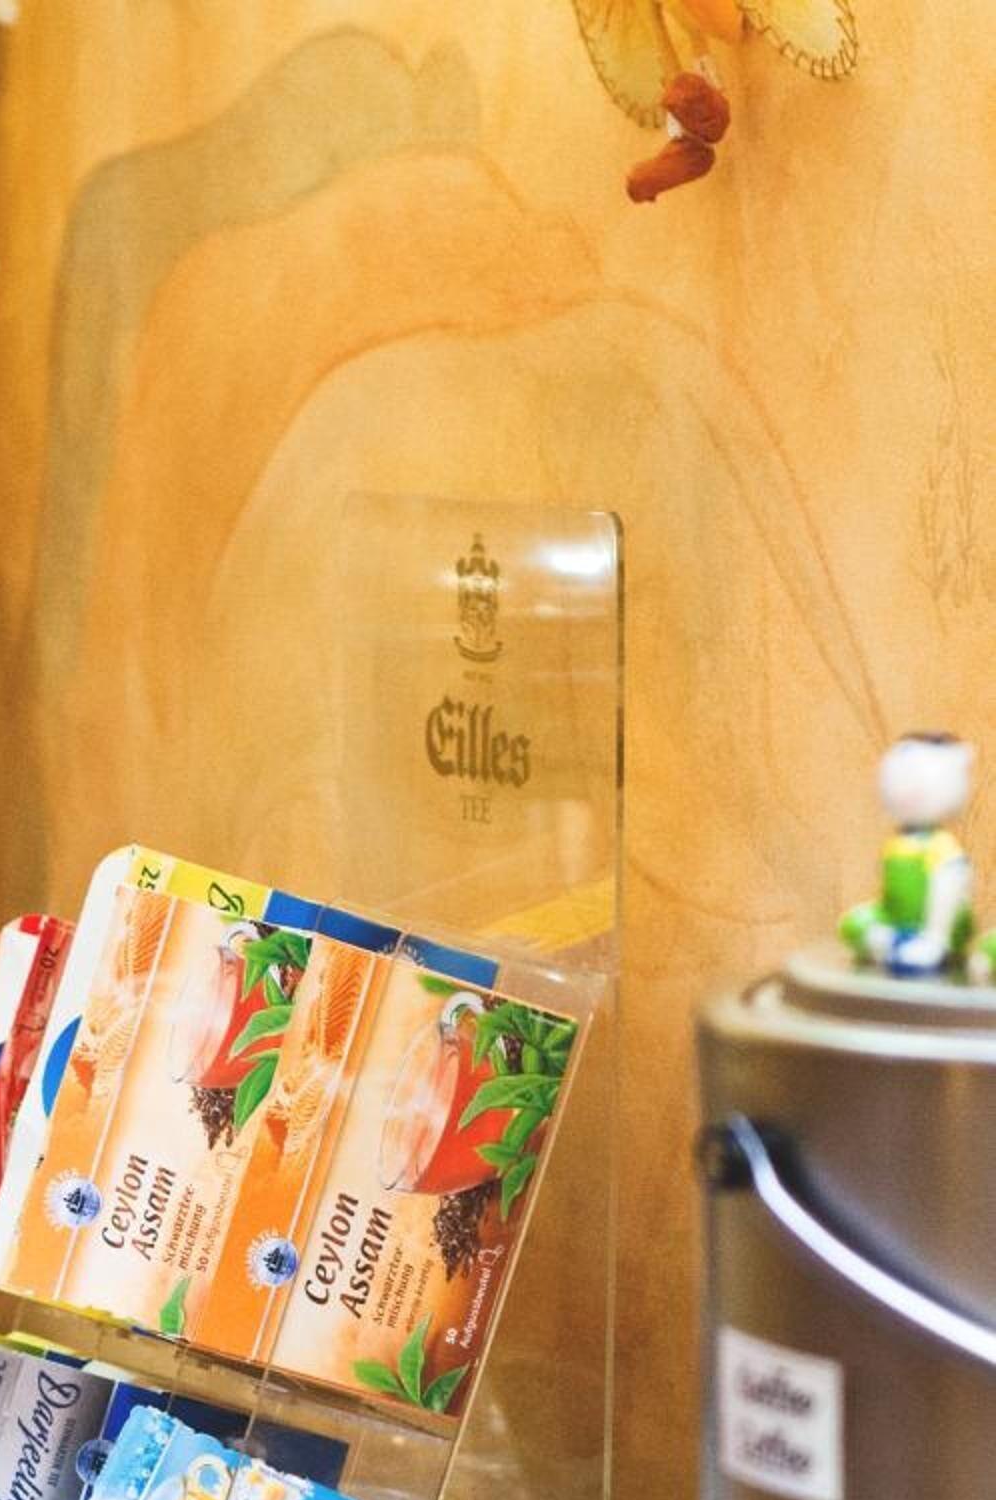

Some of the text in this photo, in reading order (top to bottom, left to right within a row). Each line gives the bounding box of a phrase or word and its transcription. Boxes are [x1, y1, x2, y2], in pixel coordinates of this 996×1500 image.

[425, 695, 532, 789] Eilles
[460, 796, 493, 825] TEE
[101, 1154, 149, 1249] Ceylon
[131, 1167, 177, 1262] Assam
[304, 1192, 360, 1306] Ceylon
[339, 1206, 393, 1319] Assam
[444, 1326, 459, 1345] 50
[459, 1266, 493, 1350] Aufgussbeutel
